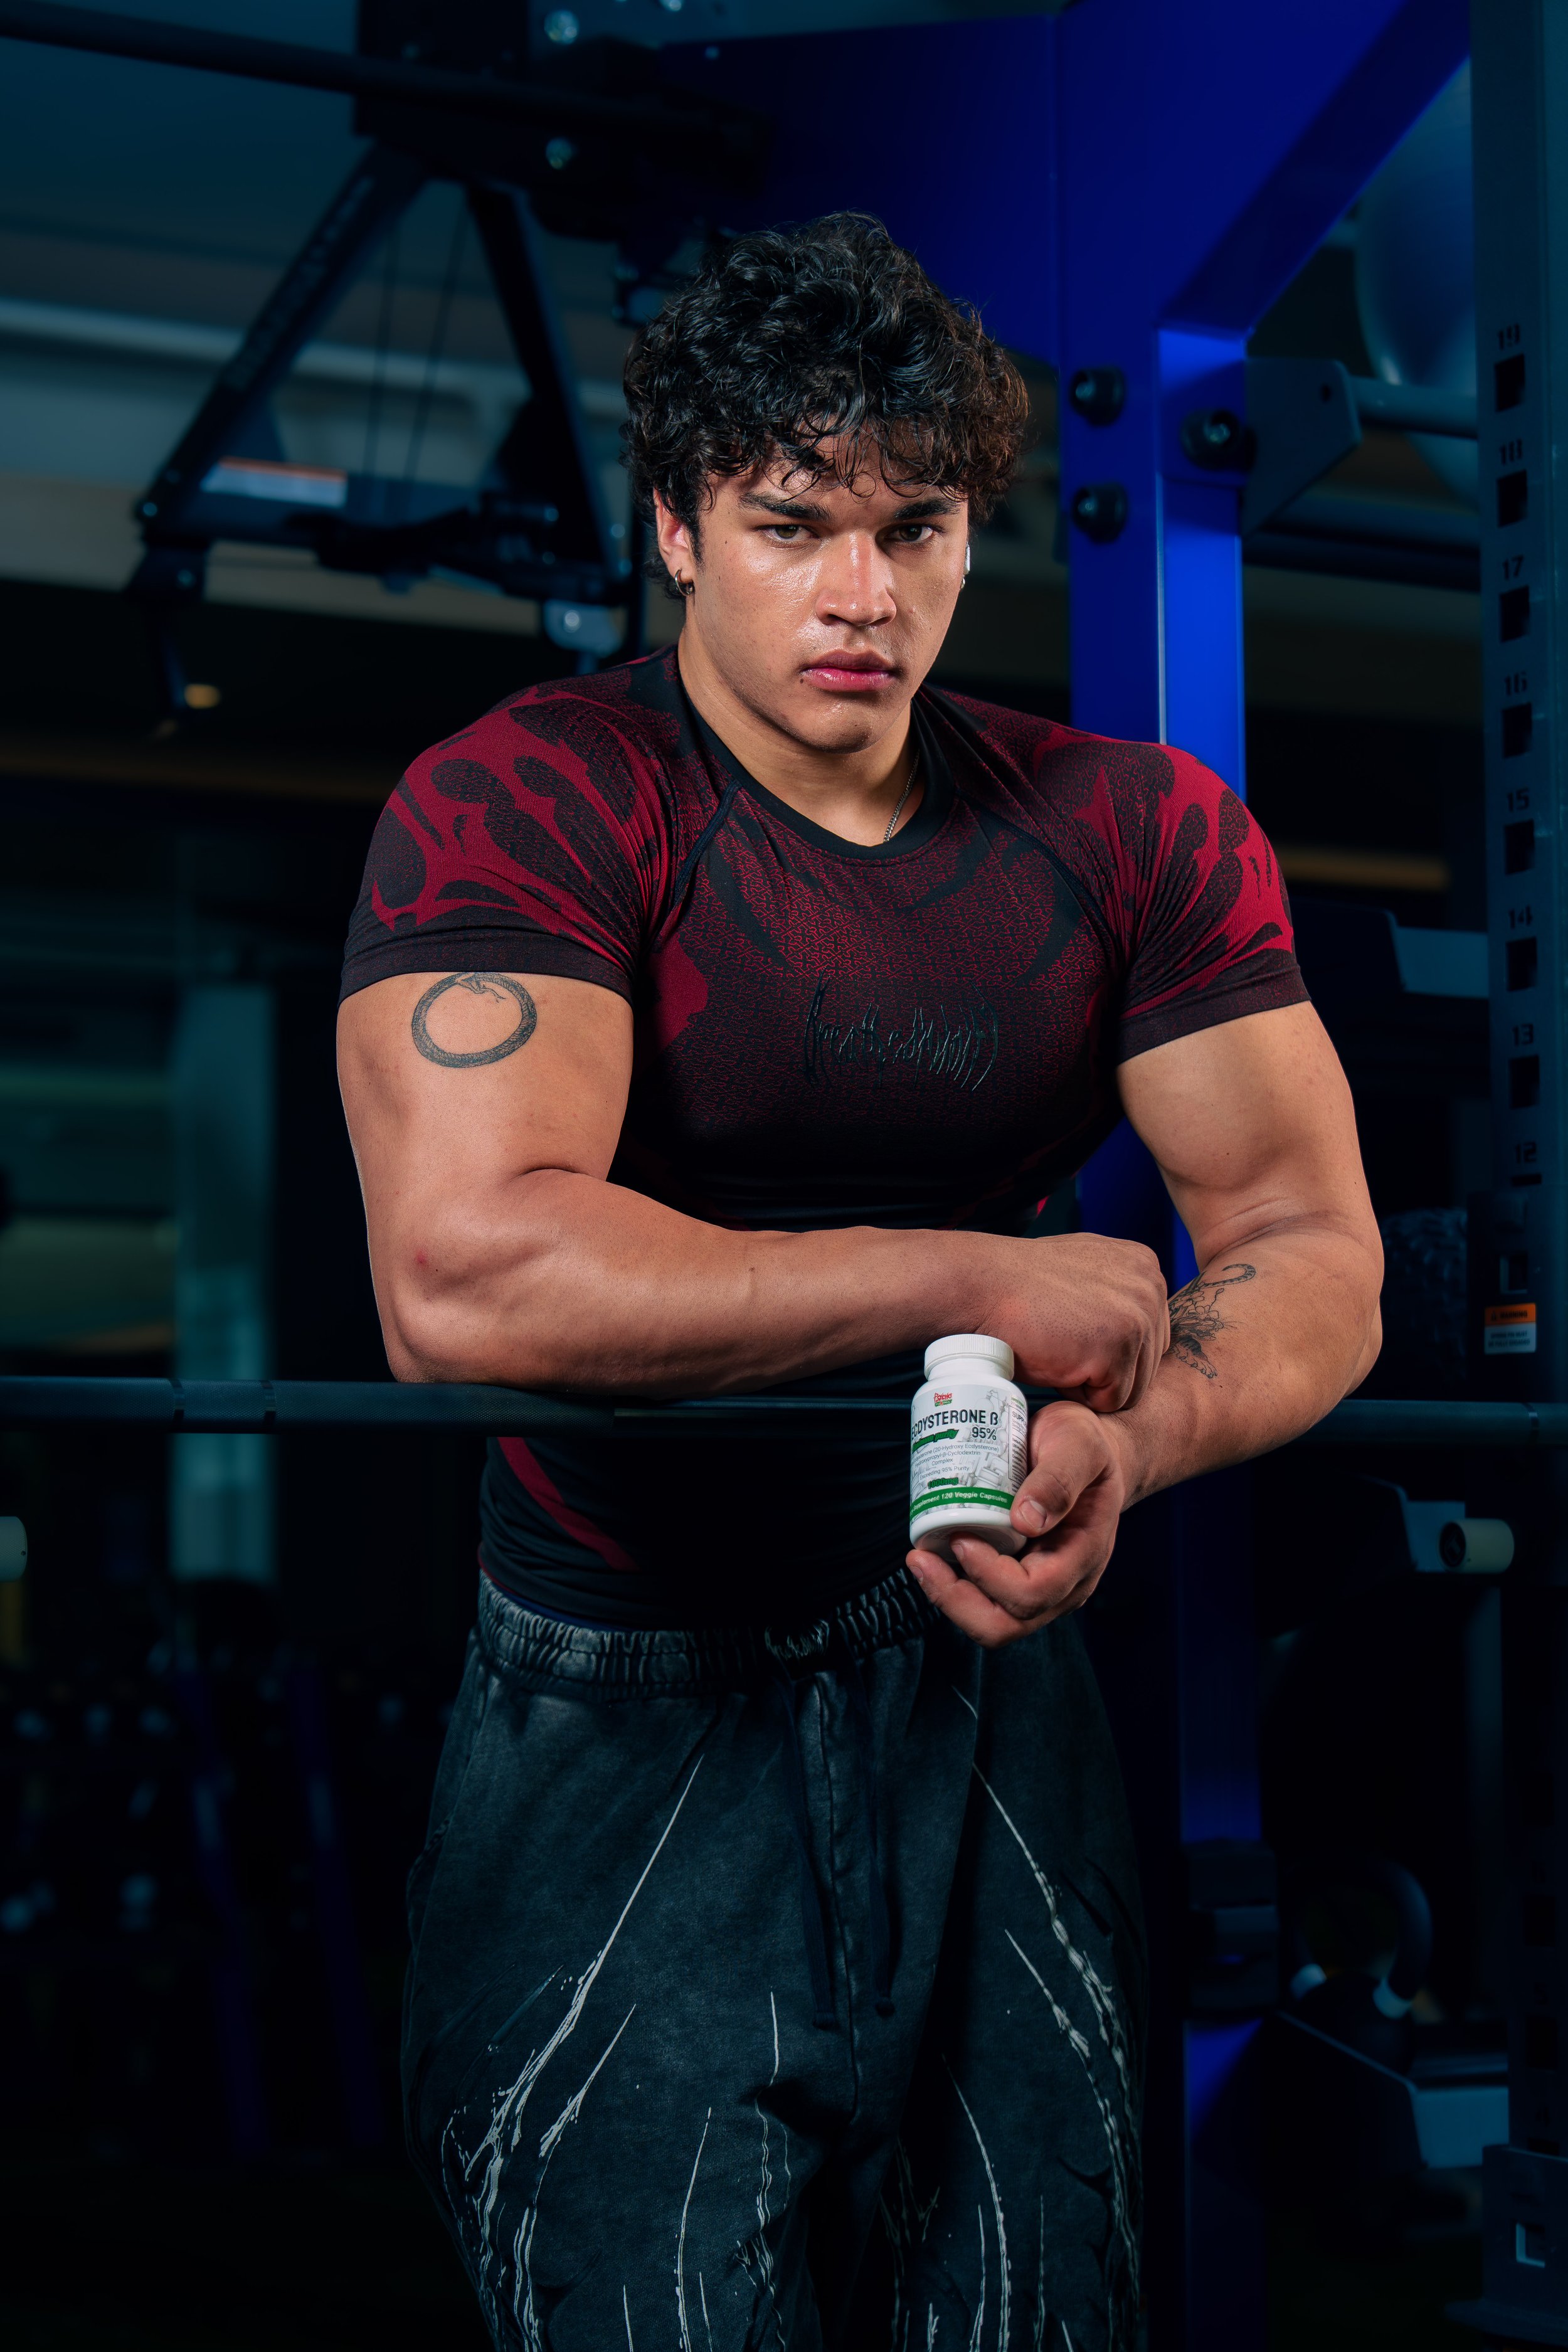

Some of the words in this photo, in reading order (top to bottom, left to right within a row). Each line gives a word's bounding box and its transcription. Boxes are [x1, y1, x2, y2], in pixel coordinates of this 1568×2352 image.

[1496, 322, 1520, 351] 19
[1502, 554, 1525, 581] 17
[1505, 670, 1528, 696] 16
[1507, 787, 1530, 812] 15
[1508, 903, 1533, 930] 14
[1512, 1023, 1535, 1047] 13
[1515, 1141, 1537, 1164] 12
[972, 1427, 997, 1441] 95%
[933, 1444, 963, 1454] (20-Hydroxy
[965, 1443, 999, 1453] Ecdysterone)
[931, 1458, 953, 1466] Complex
[919, 1469, 941, 1480] Exceeding
[954, 1491, 978, 1500] Veggie
[979, 1492, 1008, 1503] Capsules
[1533, 1982, 1549, 2006] 5
[1535, 2106, 1551, 2128] 4
